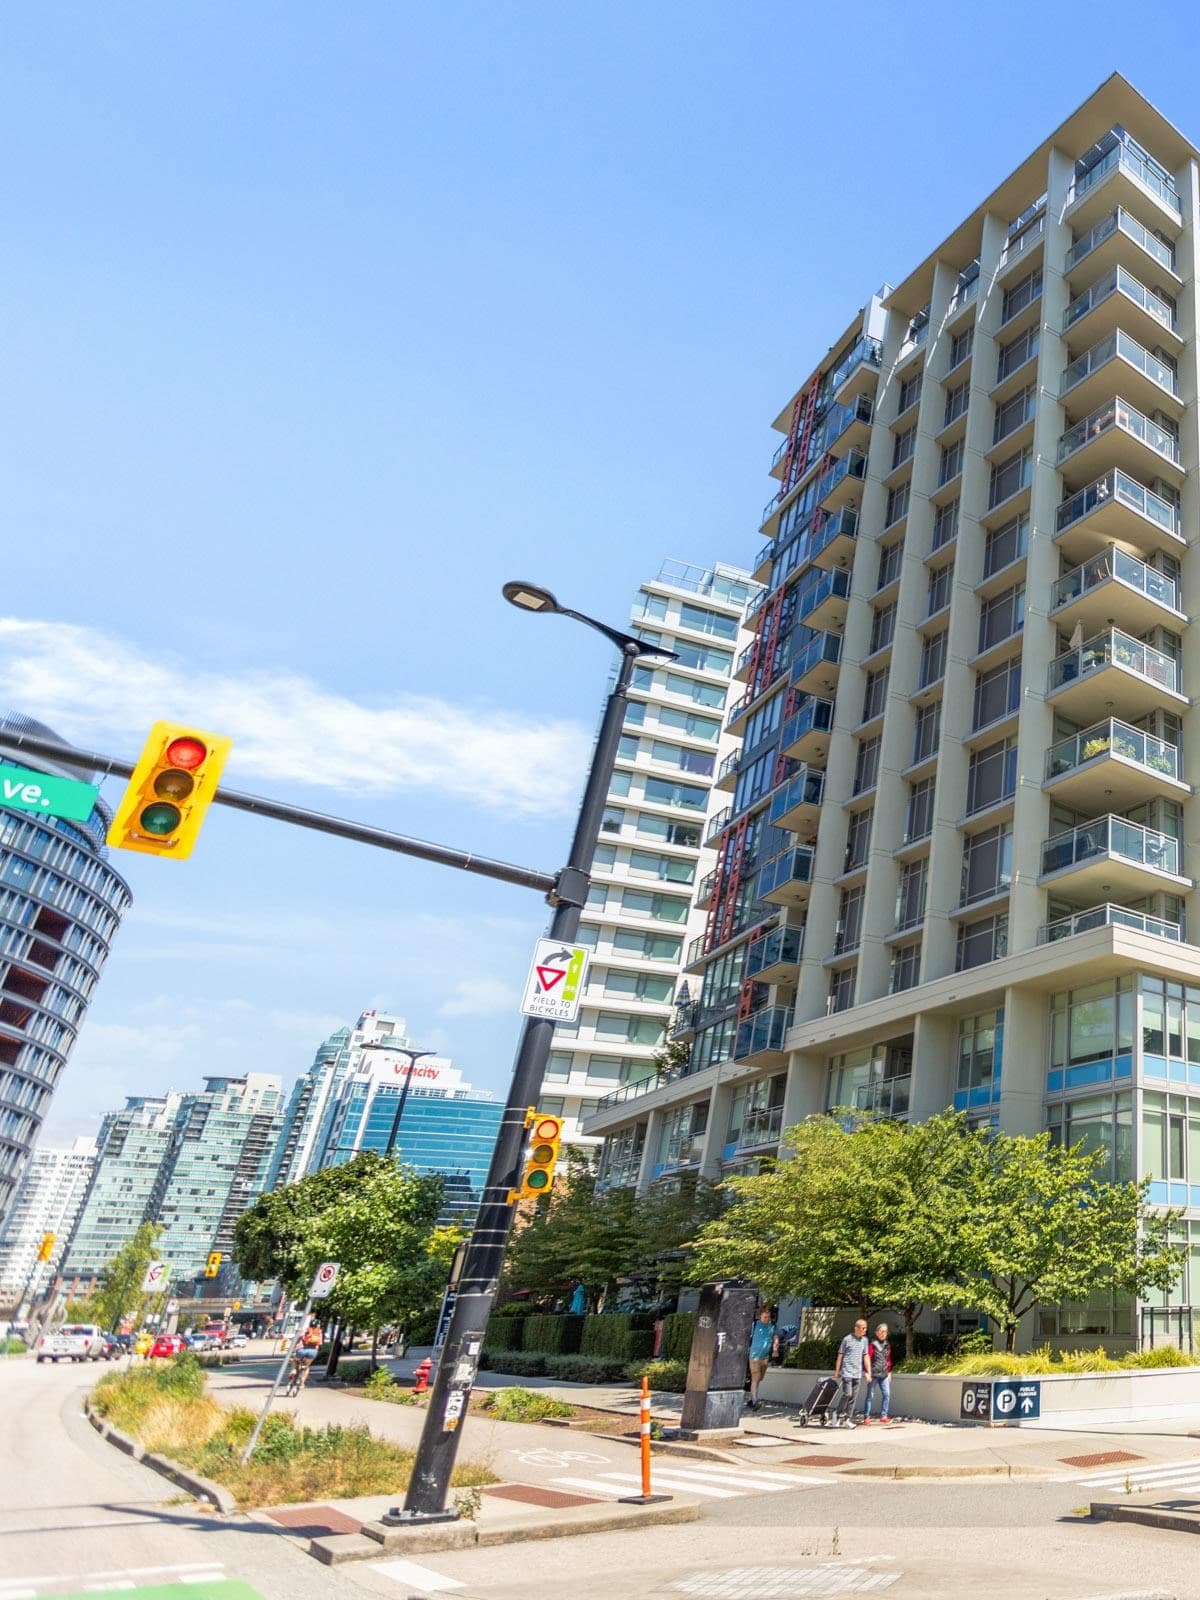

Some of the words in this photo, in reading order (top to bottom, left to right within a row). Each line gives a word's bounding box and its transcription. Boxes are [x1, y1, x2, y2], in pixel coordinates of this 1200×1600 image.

[533, 996, 556, 1006] YIELD
[560, 1001, 571, 1009] TO
[529, 1004, 569, 1017] BICYCLES
